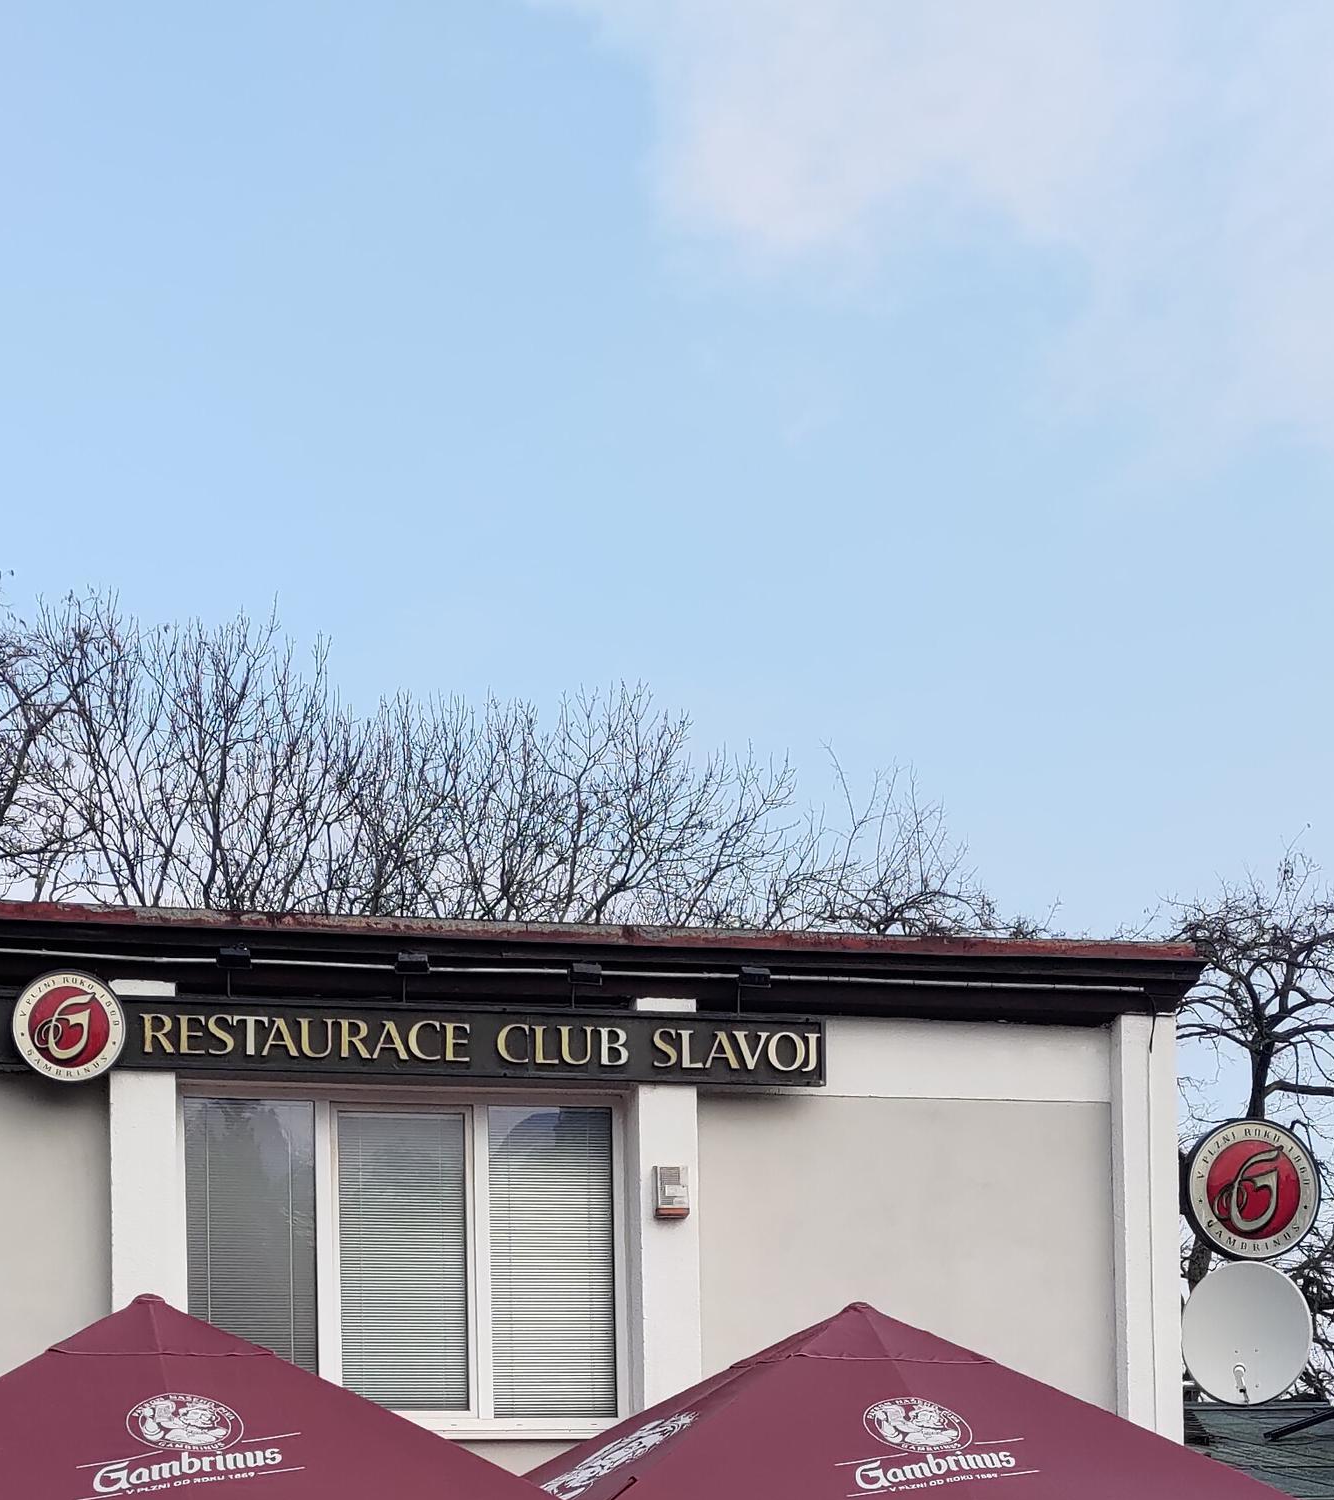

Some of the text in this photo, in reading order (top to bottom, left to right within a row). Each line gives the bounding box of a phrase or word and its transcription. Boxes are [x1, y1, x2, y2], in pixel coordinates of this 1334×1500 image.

[139, 1012, 821, 1072] RESTAURACE CLUB SLAVOJ
[27, 1049, 108, 1077] GAMBRINUS
[1207, 1219, 1300, 1252] GAMBRINUS
[93, 1448, 282, 1493] Gambrinus
[136, 1483, 171, 1493] PLZNI
[173, 1479, 191, 1487] OD
[193, 1475, 225, 1484] ROKU
[855, 1451, 1016, 1490] Gambrinus
[929, 1479, 944, 1487] OD
[946, 1474, 974, 1483] ROKU
